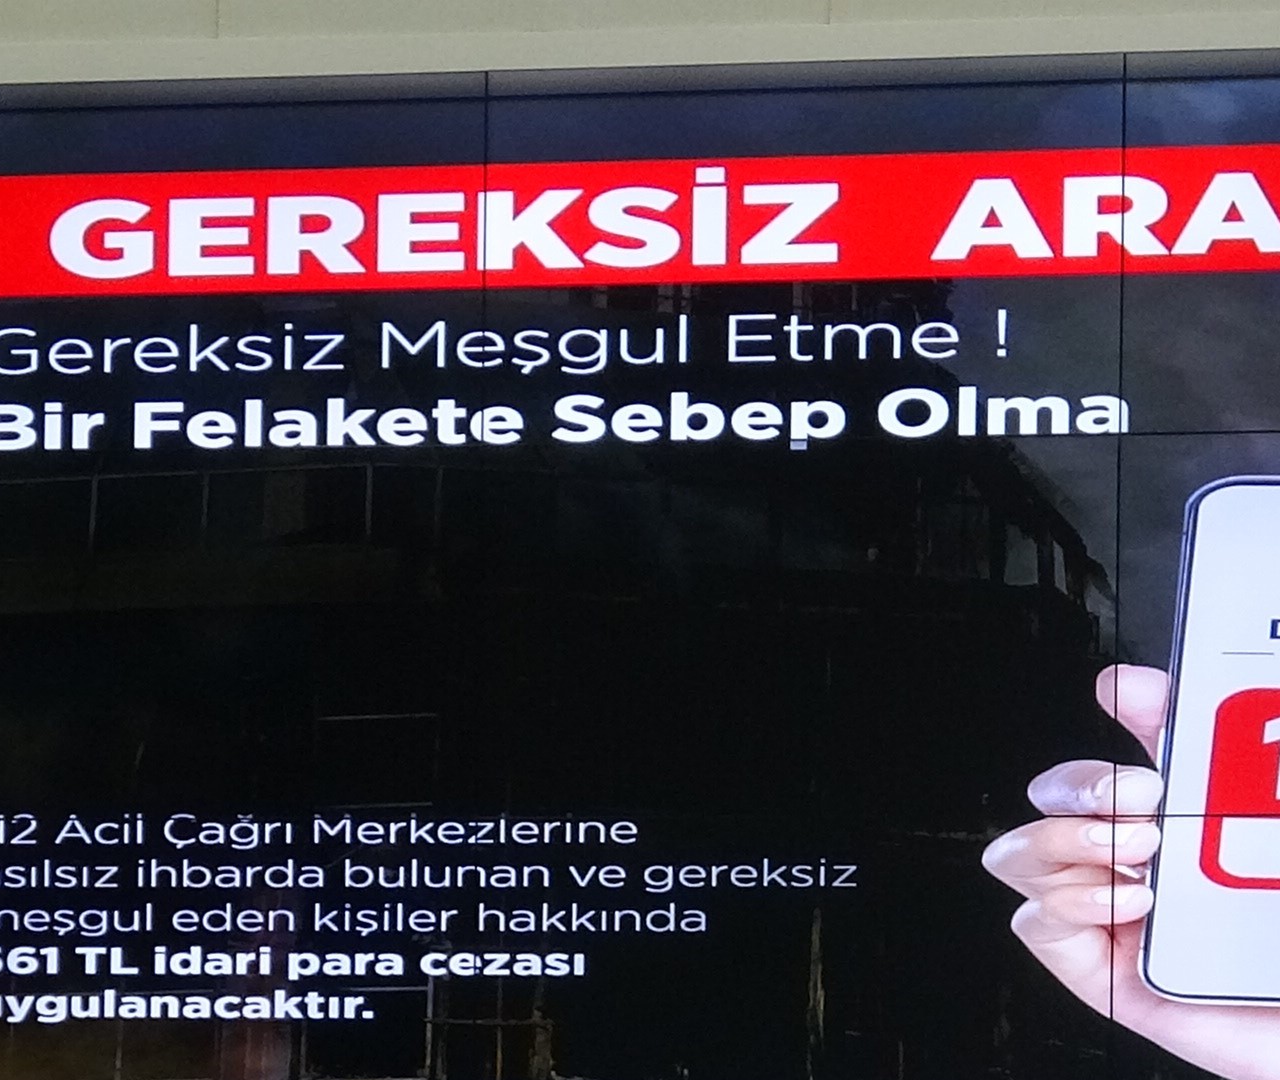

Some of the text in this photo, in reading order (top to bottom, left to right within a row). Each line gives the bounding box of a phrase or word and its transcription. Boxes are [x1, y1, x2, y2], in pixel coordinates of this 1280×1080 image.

[382, 314, 687, 375] Meşgul
[728, 313, 959, 363] Etme
[996, 308, 1007, 358] !
[133, 397, 523, 449] Felakete
[551, 391, 846, 450] Sebep
[877, 385, 1129, 438] Olma
[54, 813, 143, 845] Acil
[163, 813, 292, 850] Çağrı
[314, 814, 638, 845] Merkezlerine
[137, 858, 324, 888] ihbarda
[344, 858, 550, 888] bulunan
[569, 865, 626, 888] ve
[644, 858, 857, 893] gereksiz
[172, 902, 295, 932] eden
[315, 902, 458, 937] kişiler
[478, 902, 706, 932] hakkında
[75, 946, 139, 975] TL
[154, 945, 272, 976] idari
[288, 952, 404, 981] para
[420, 952, 585, 977] cezası
